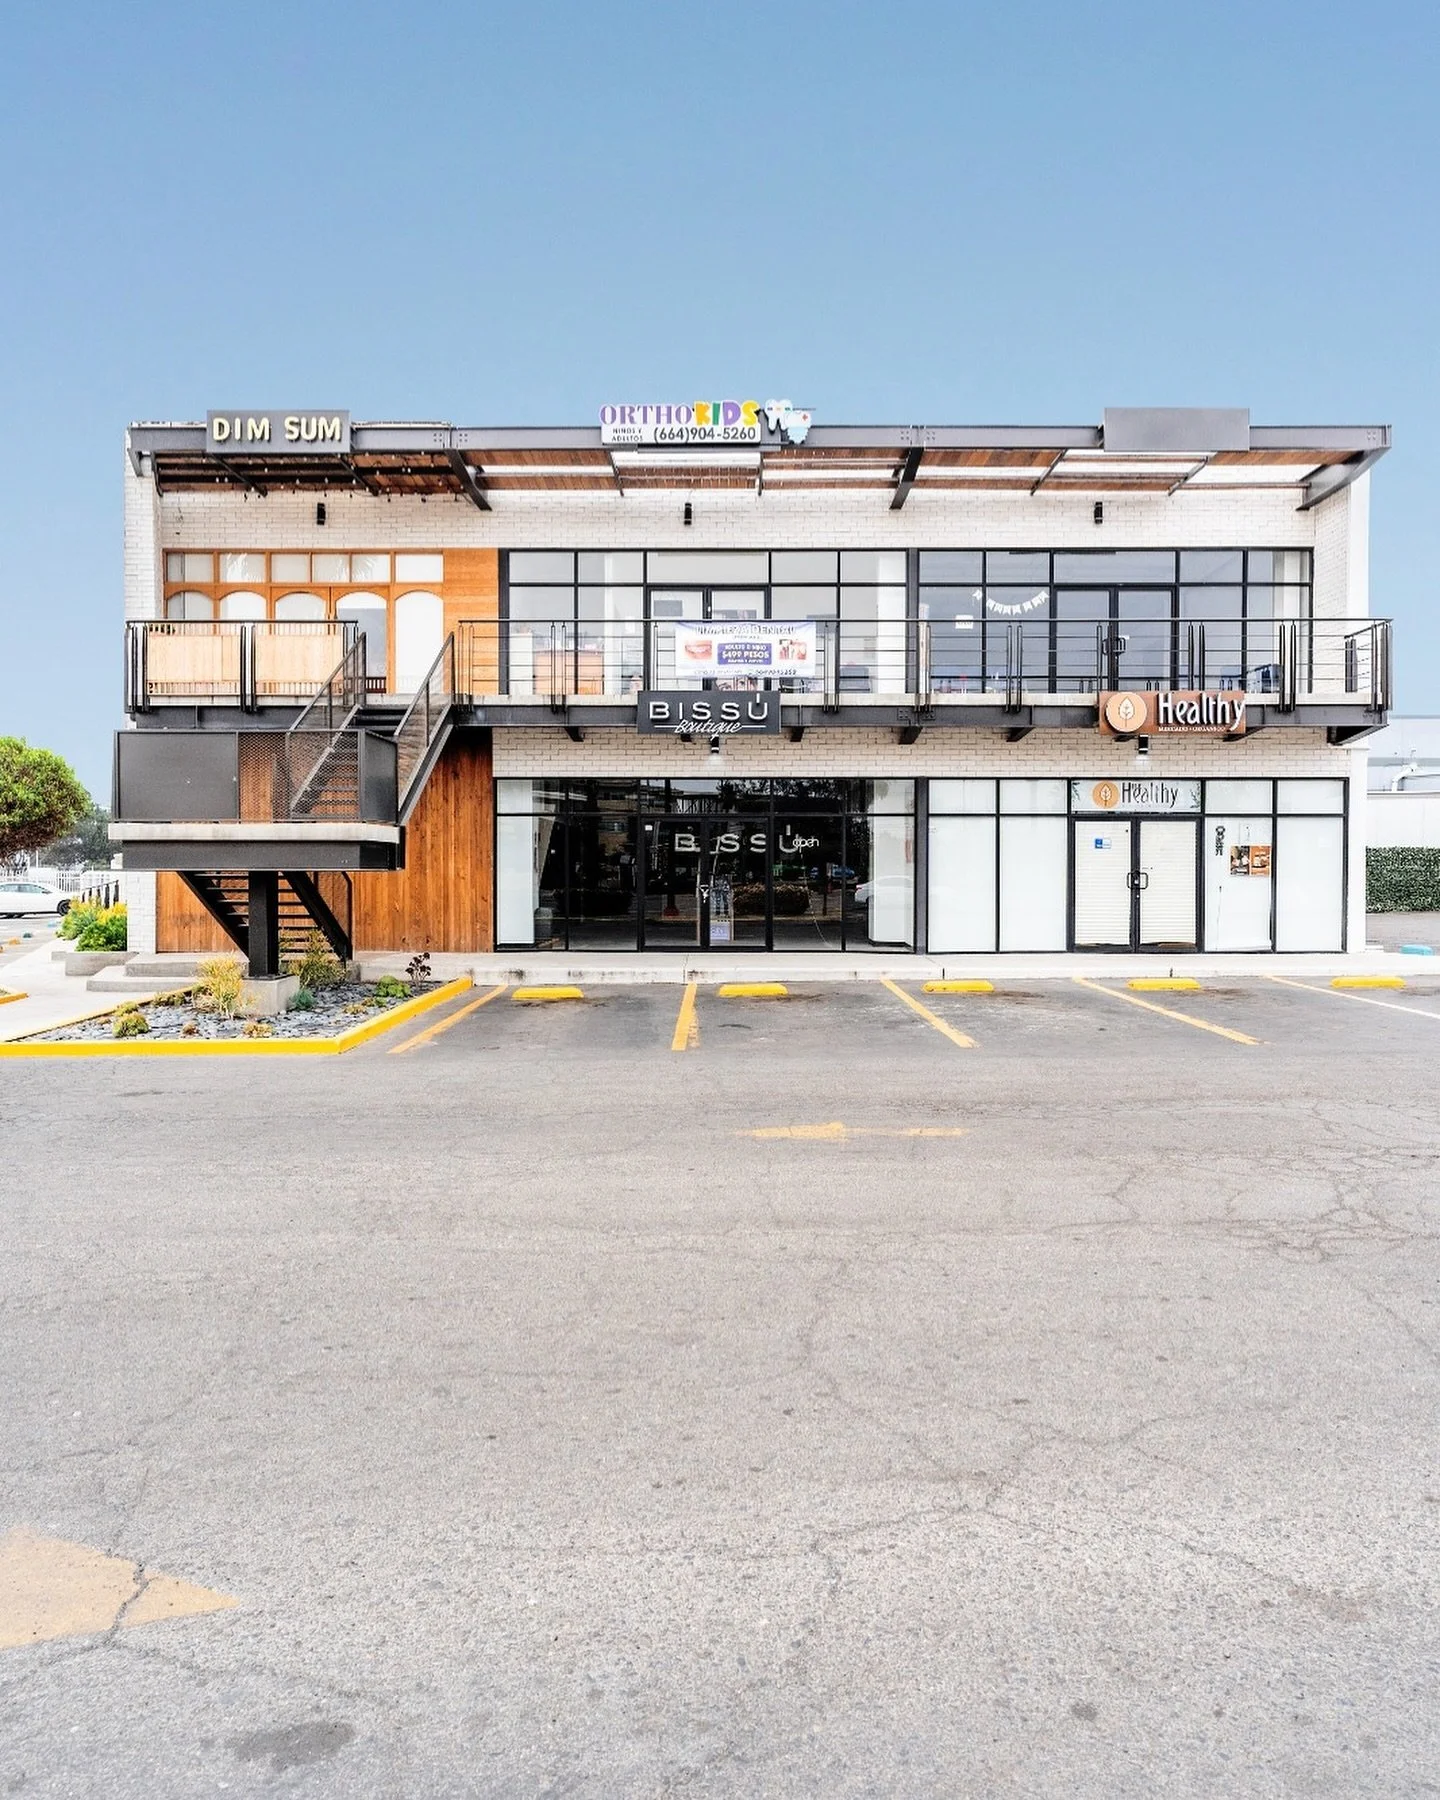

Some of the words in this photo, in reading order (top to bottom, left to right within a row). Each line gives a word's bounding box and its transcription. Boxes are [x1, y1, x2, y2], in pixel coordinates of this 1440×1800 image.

[213, 417, 271, 441] DIM
[284, 416, 341, 441] SUM
[653, 426, 756, 443] (664)904-5260
[743, 651, 769, 659] PESOS
[1159, 692, 1246, 732] Healthy
[674, 719, 743, 741] Boutique
[1122, 782, 1179, 808] Healthy
